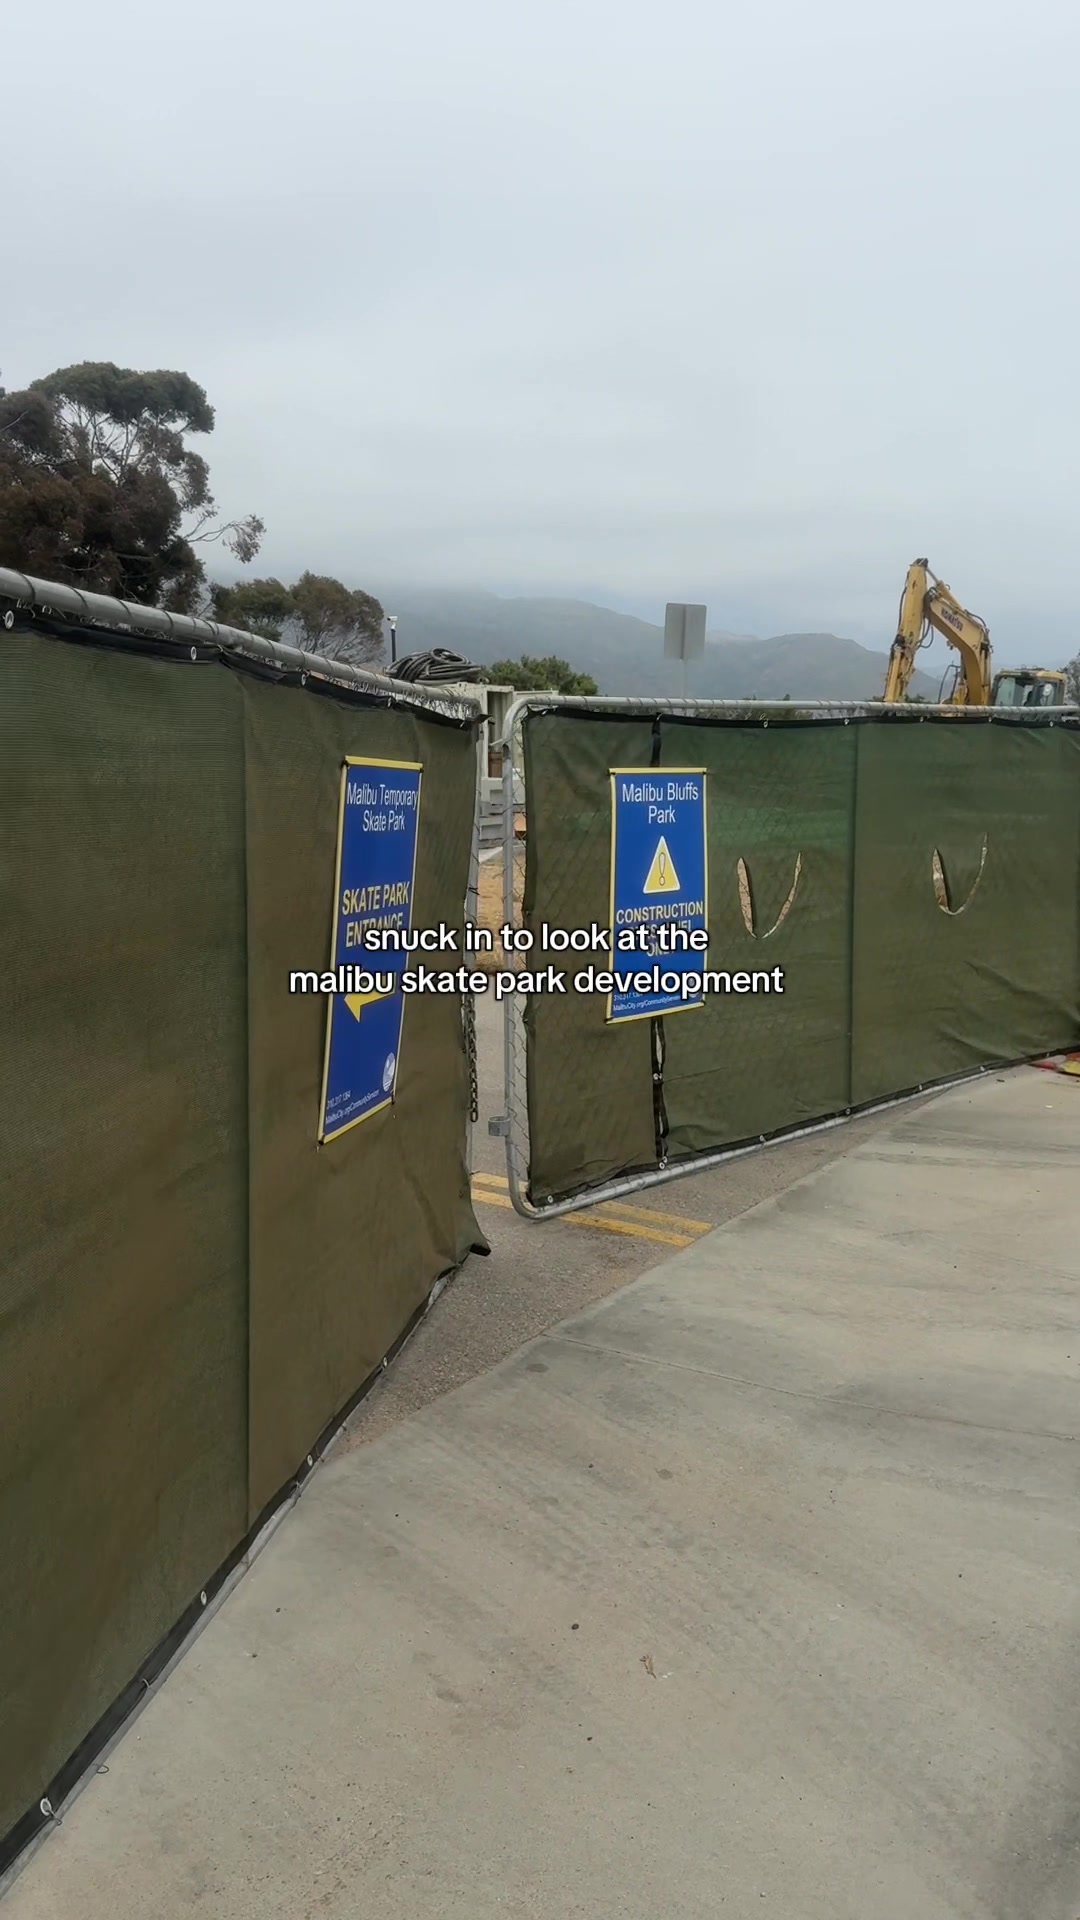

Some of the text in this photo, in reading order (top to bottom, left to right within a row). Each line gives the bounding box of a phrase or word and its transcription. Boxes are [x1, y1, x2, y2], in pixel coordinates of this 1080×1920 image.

[941, 607, 963, 631] KOMATSU
[347, 782, 418, 811] Malibu Temporary
[622, 782, 699, 802] Malibu Bluffs
[362, 810, 406, 832] Skate Park
[648, 805, 676, 824] Park
[342, 881, 410, 915] SKATE PARK
[616, 901, 704, 924] CONSTRUCTION
